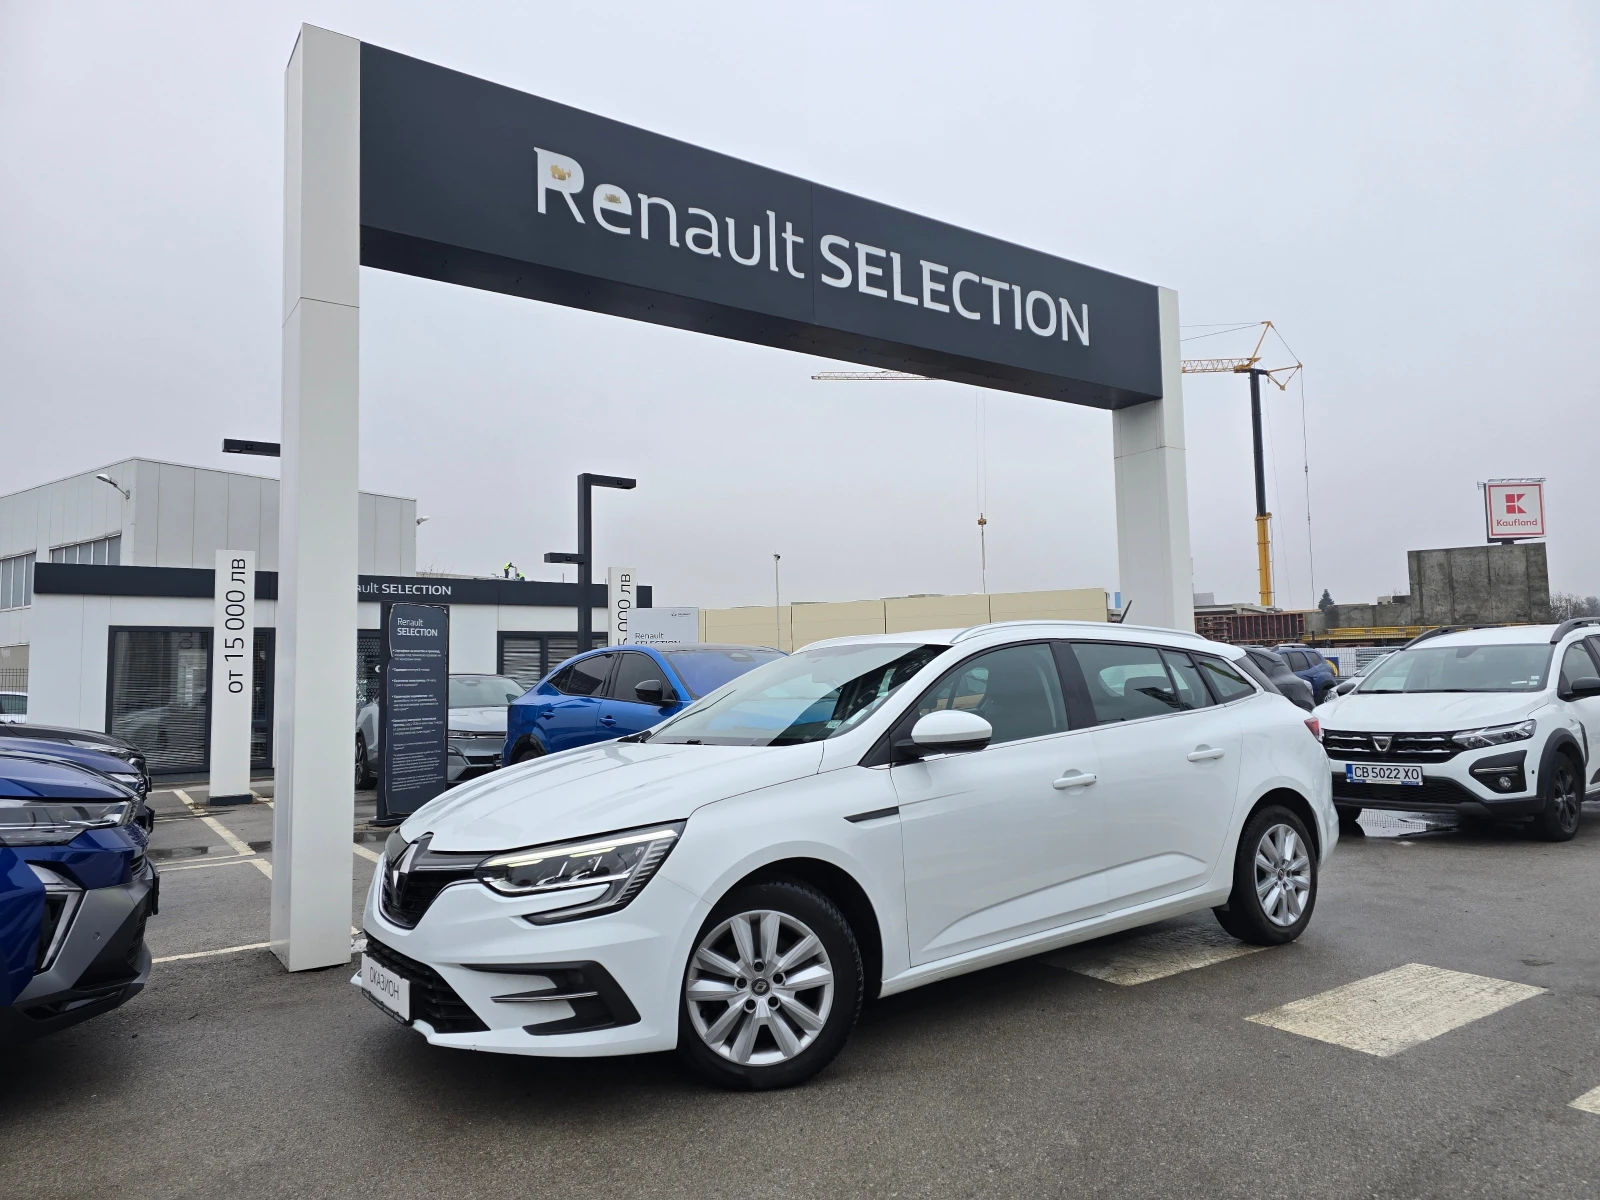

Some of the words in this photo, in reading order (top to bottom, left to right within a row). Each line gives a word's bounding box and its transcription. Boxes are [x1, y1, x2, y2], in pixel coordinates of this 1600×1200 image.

[533, 146, 805, 279] Renault
[820, 234, 1090, 346] SELECTION
[1496, 518, 1538, 527] Kaufland
[357, 582, 380, 593] ault
[381, 583, 452, 596] SELECTION
[225, 590, 245, 630] 000
[397, 617, 424, 627] Renault
[397, 627, 438, 637] SELECTION
[635, 632, 664, 640] Renault
[224, 637, 245, 662] 15
[1354, 767, 1369, 778] CB
[1372, 767, 1400, 779] 5022
[1403, 768, 1419, 780] XO
